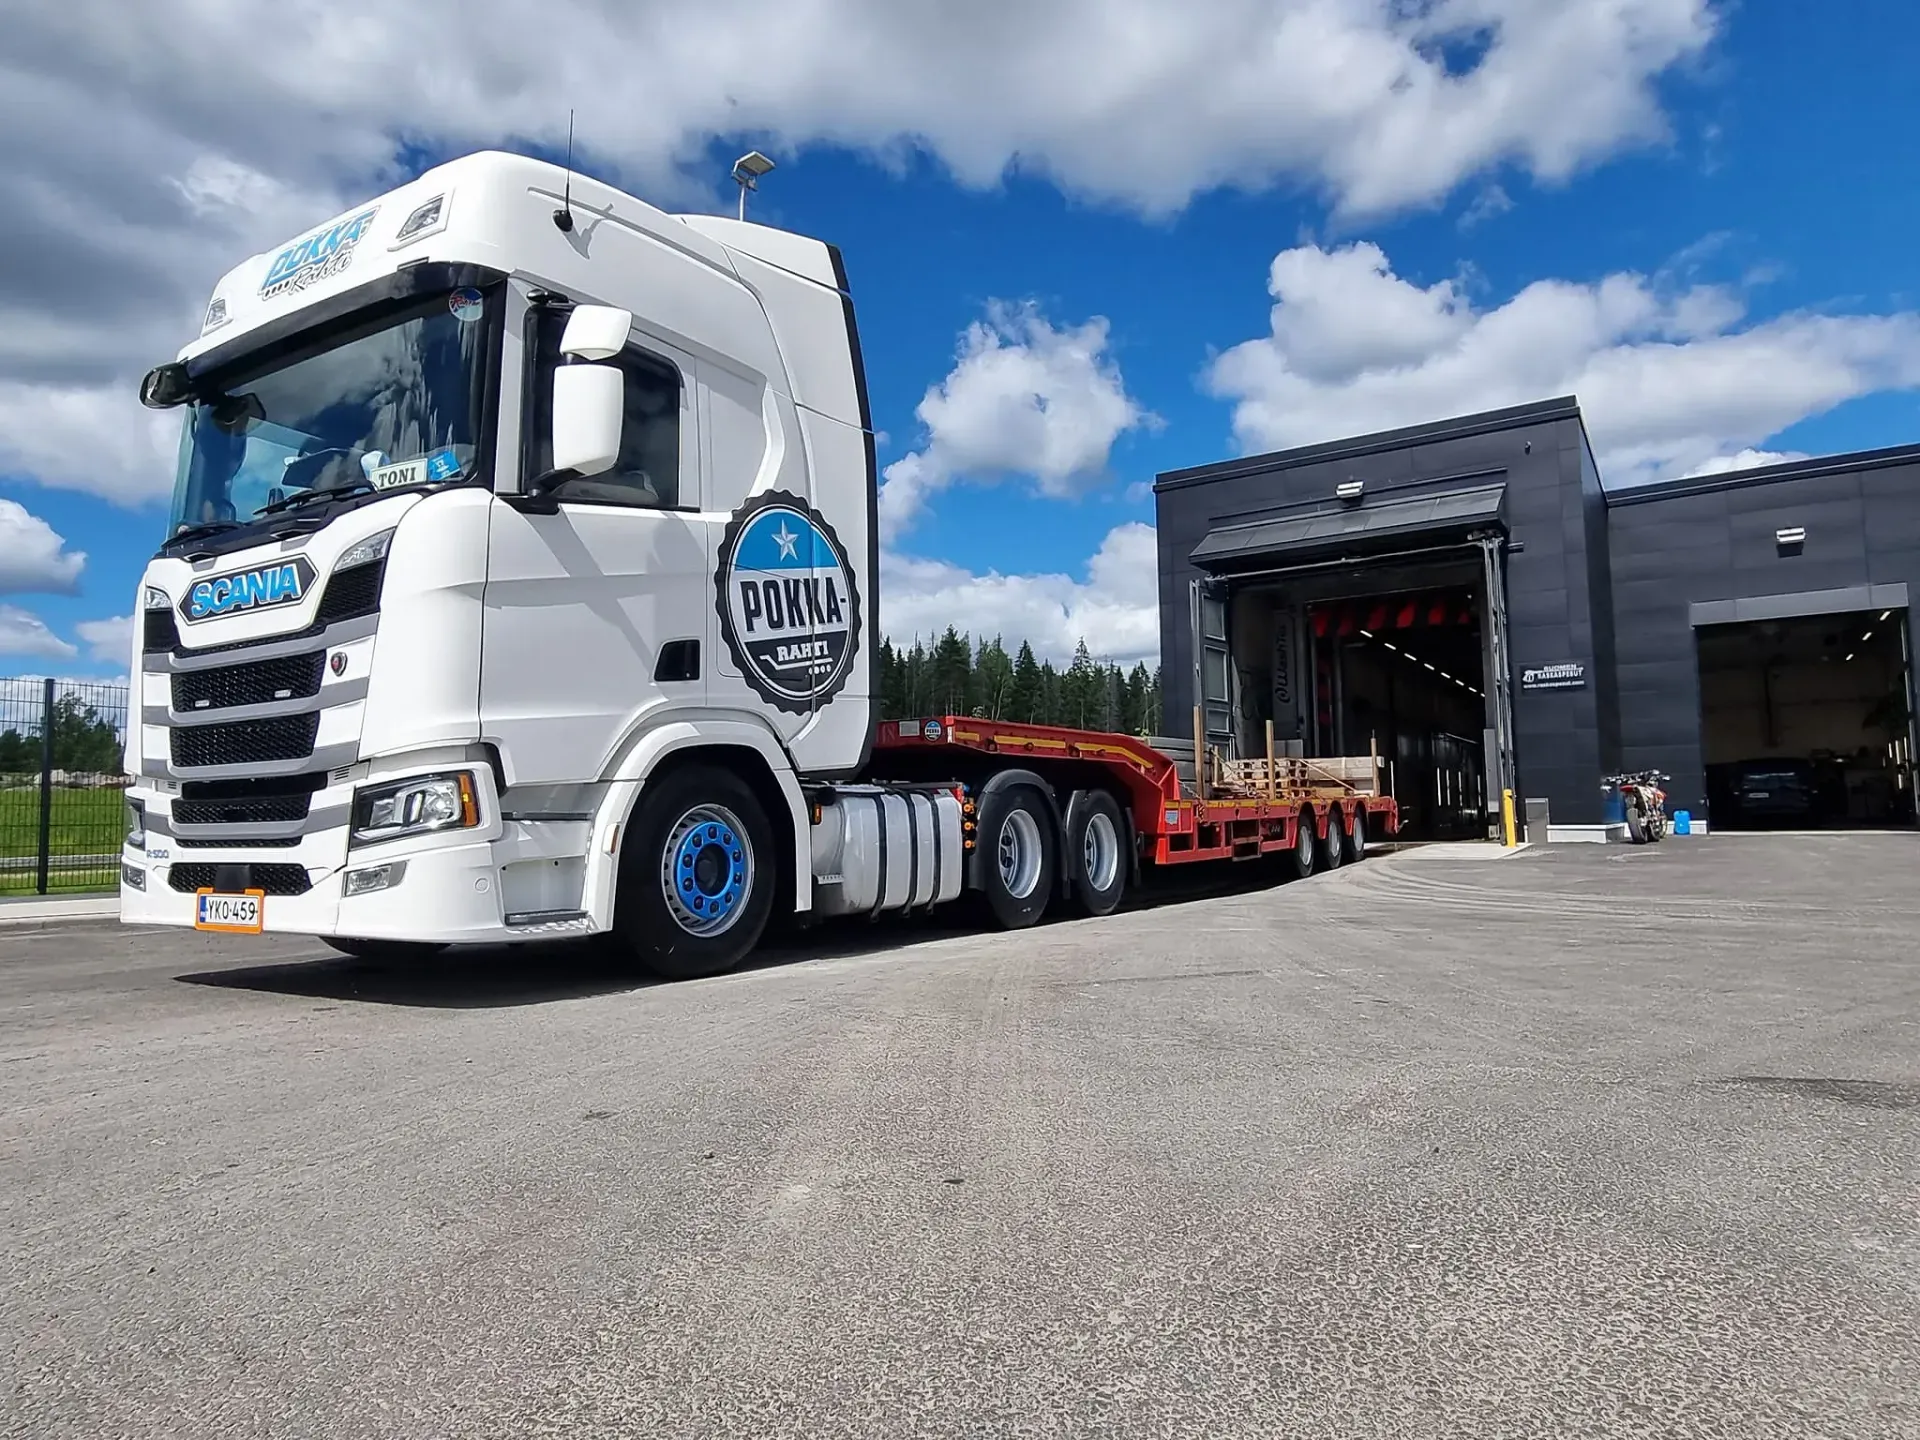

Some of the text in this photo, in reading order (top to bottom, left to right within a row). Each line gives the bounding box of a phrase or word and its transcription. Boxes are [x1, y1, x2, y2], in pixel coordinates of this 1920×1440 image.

[379, 466, 416, 488] TONI
[191, 563, 302, 618] SCANIA
[776, 640, 829, 662] RAHTI
